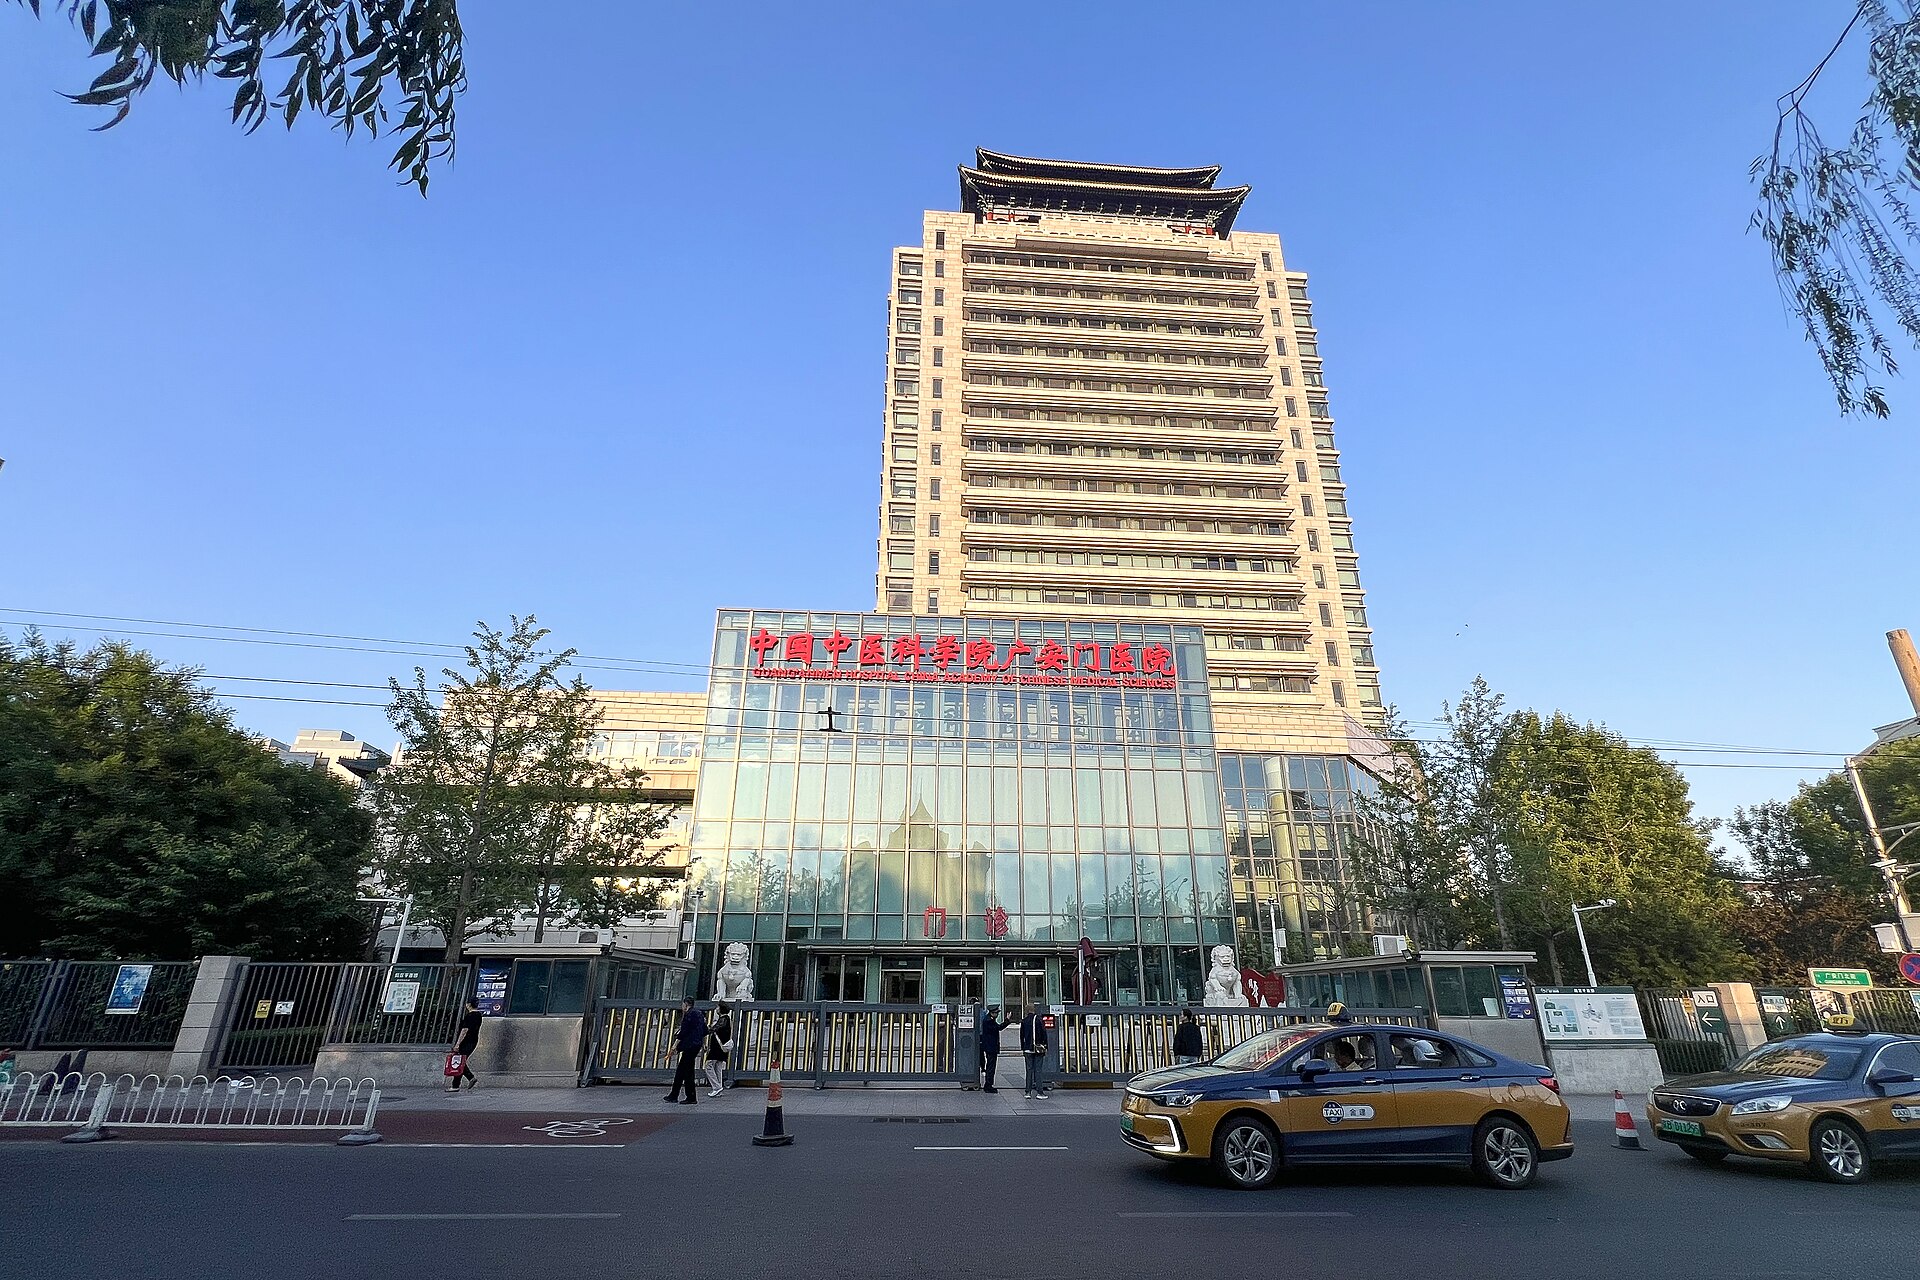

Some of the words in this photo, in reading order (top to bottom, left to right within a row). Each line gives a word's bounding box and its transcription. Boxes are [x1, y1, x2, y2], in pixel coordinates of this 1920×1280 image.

[750, 628, 1176, 677] 中国中医科学院广安门医院
[845, 669, 900, 682] HOSPITAL
[904, 671, 938, 683] CHINA
[943, 672, 998, 684] ACADEMY
[1002, 673, 1017, 685] OF
[1021, 674, 1067, 687] CHINESE
[1070, 675, 1118, 688] MEDICAL
[1122, 676, 1176, 689] SCIENCES
[924, 905, 1009, 938] 门诊
[1697, 994, 1714, 1004] 入口
[959, 1005, 972, 1014] 出口
[1324, 1108, 1343, 1116] TAXI
